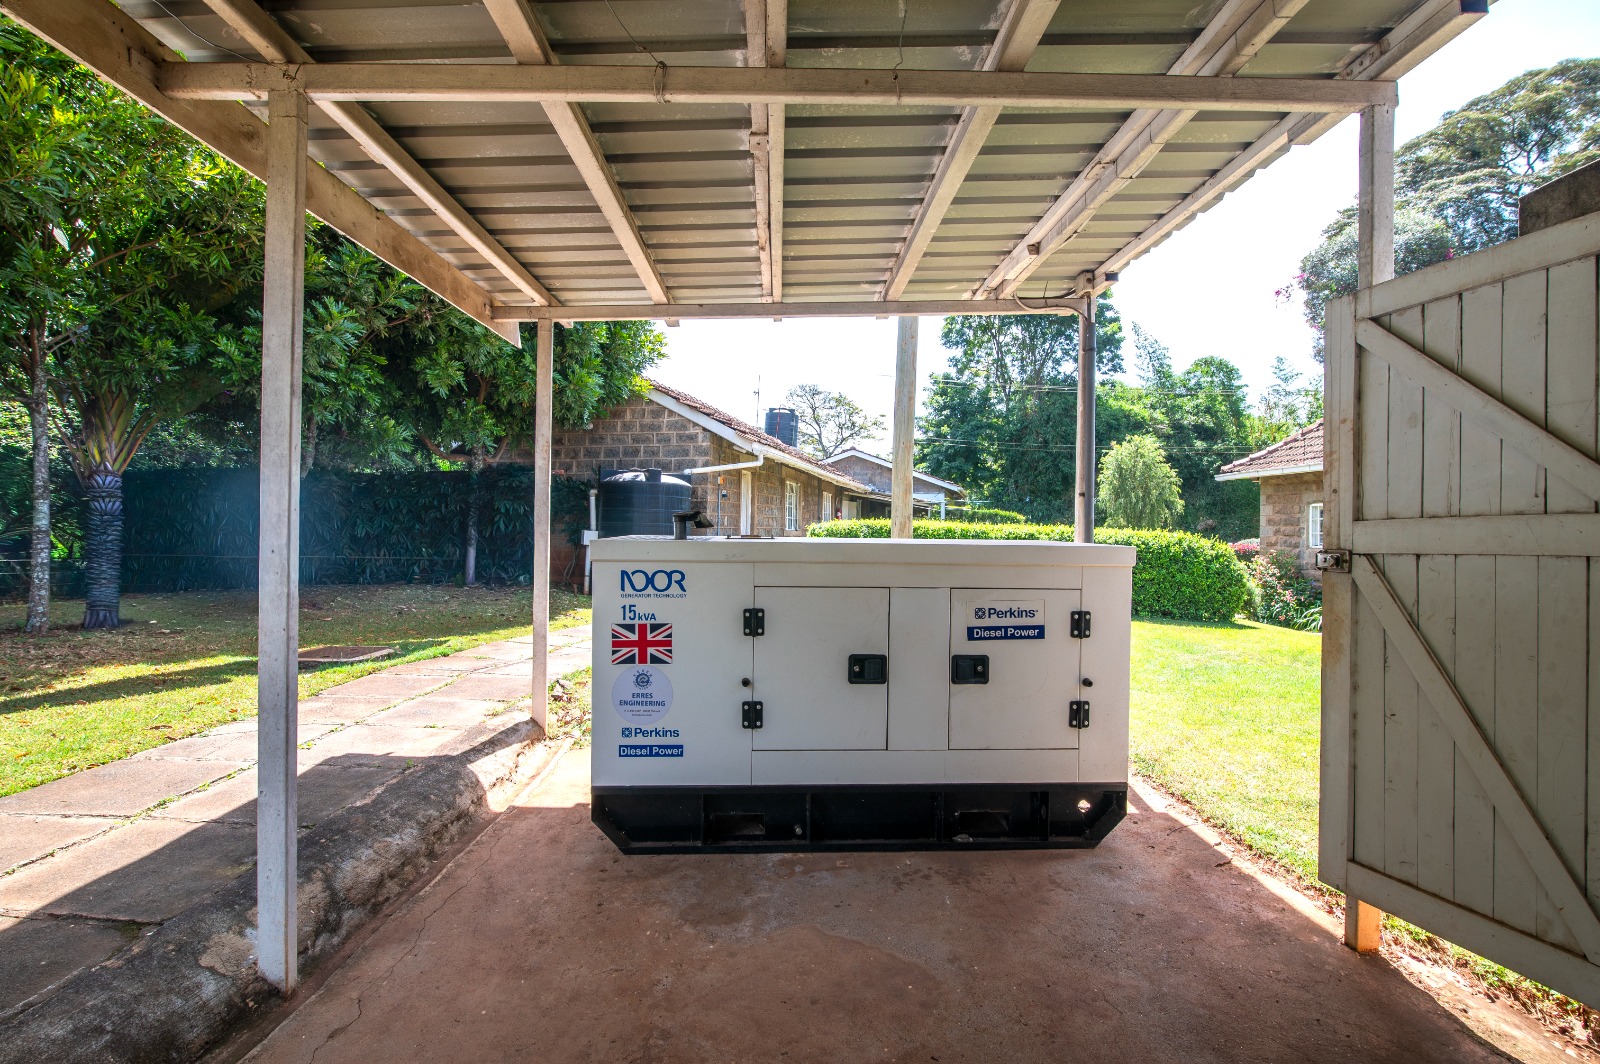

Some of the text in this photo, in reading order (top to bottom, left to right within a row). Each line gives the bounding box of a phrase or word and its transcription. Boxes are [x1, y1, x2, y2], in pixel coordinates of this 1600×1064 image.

[621, 570, 686, 592] NOOR
[988, 607, 1036, 618] Perkins
[974, 627, 1039, 638] Diesel Power
[634, 727, 680, 738] Perkins
[620, 746, 682, 755] Diesel Power
